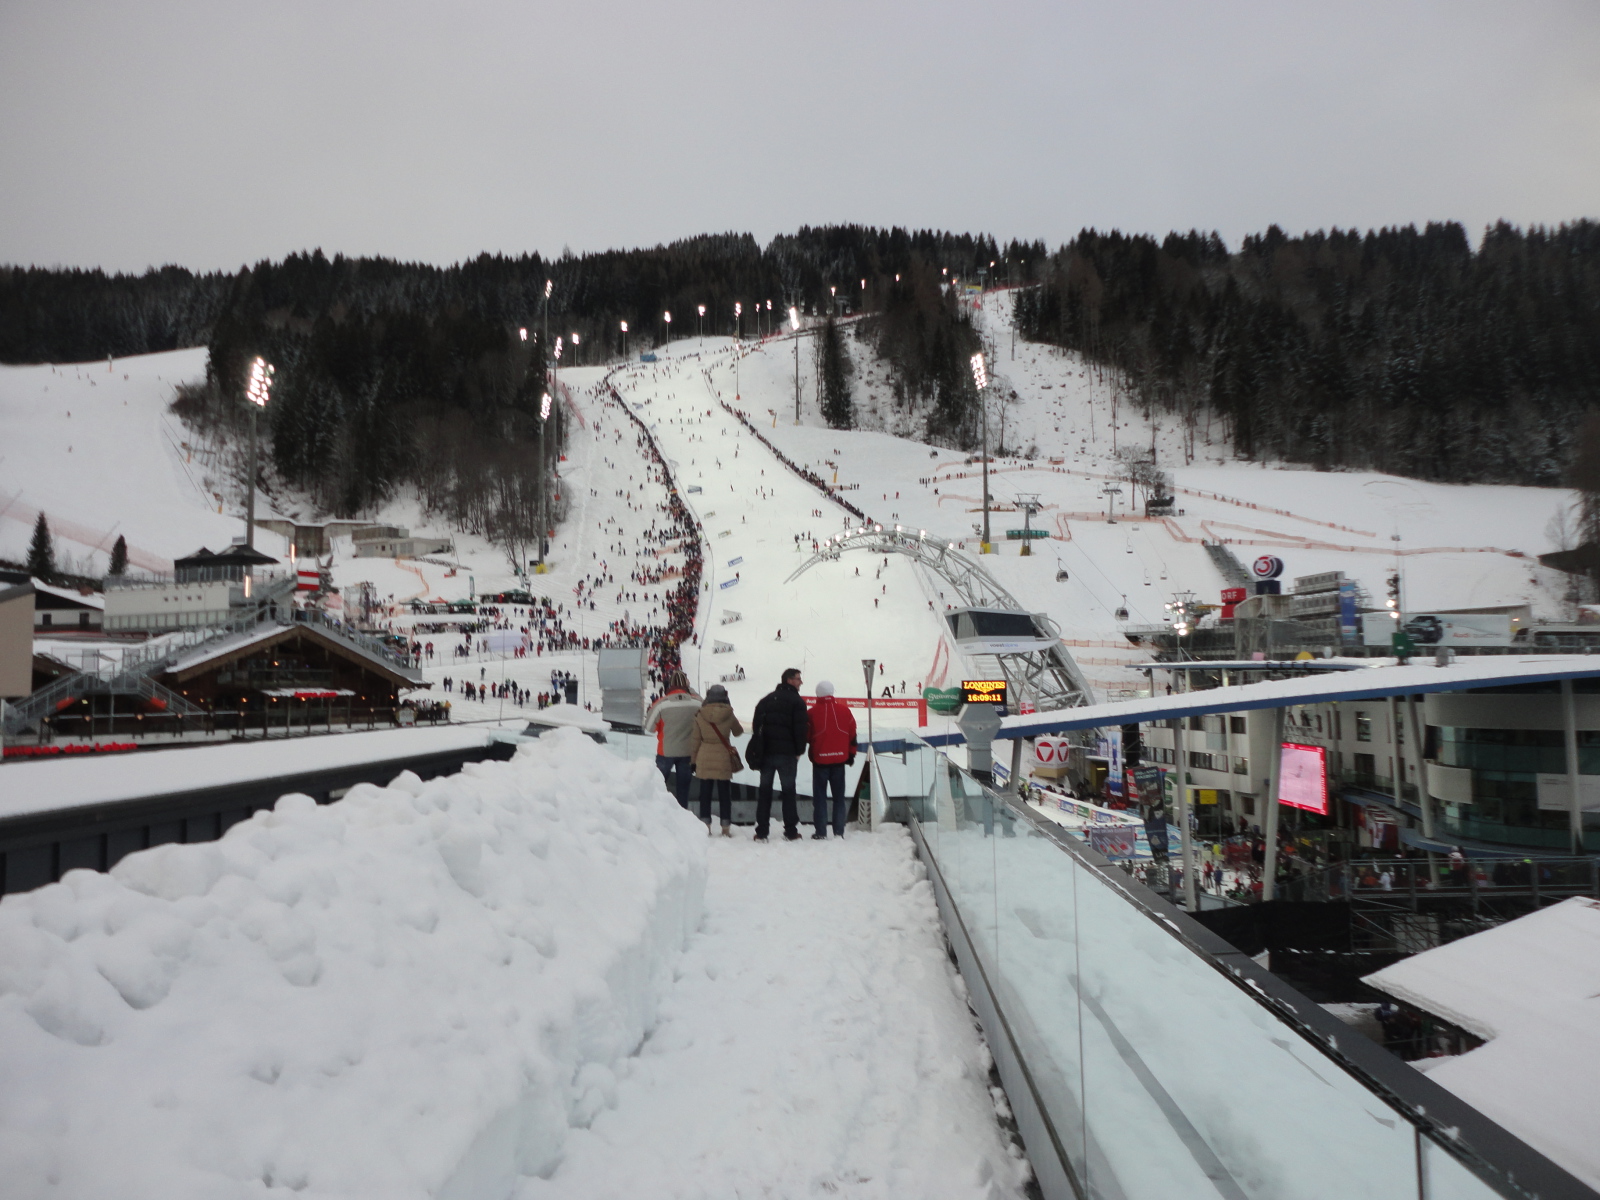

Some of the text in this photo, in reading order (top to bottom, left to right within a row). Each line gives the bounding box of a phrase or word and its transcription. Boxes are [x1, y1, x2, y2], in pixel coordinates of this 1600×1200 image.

[1221, 591, 1237, 600] ORF
[963, 681, 1006, 689] LONGINES
[881, 684, 895, 698] A1
[967, 694, 1002, 702] 16:09:11
